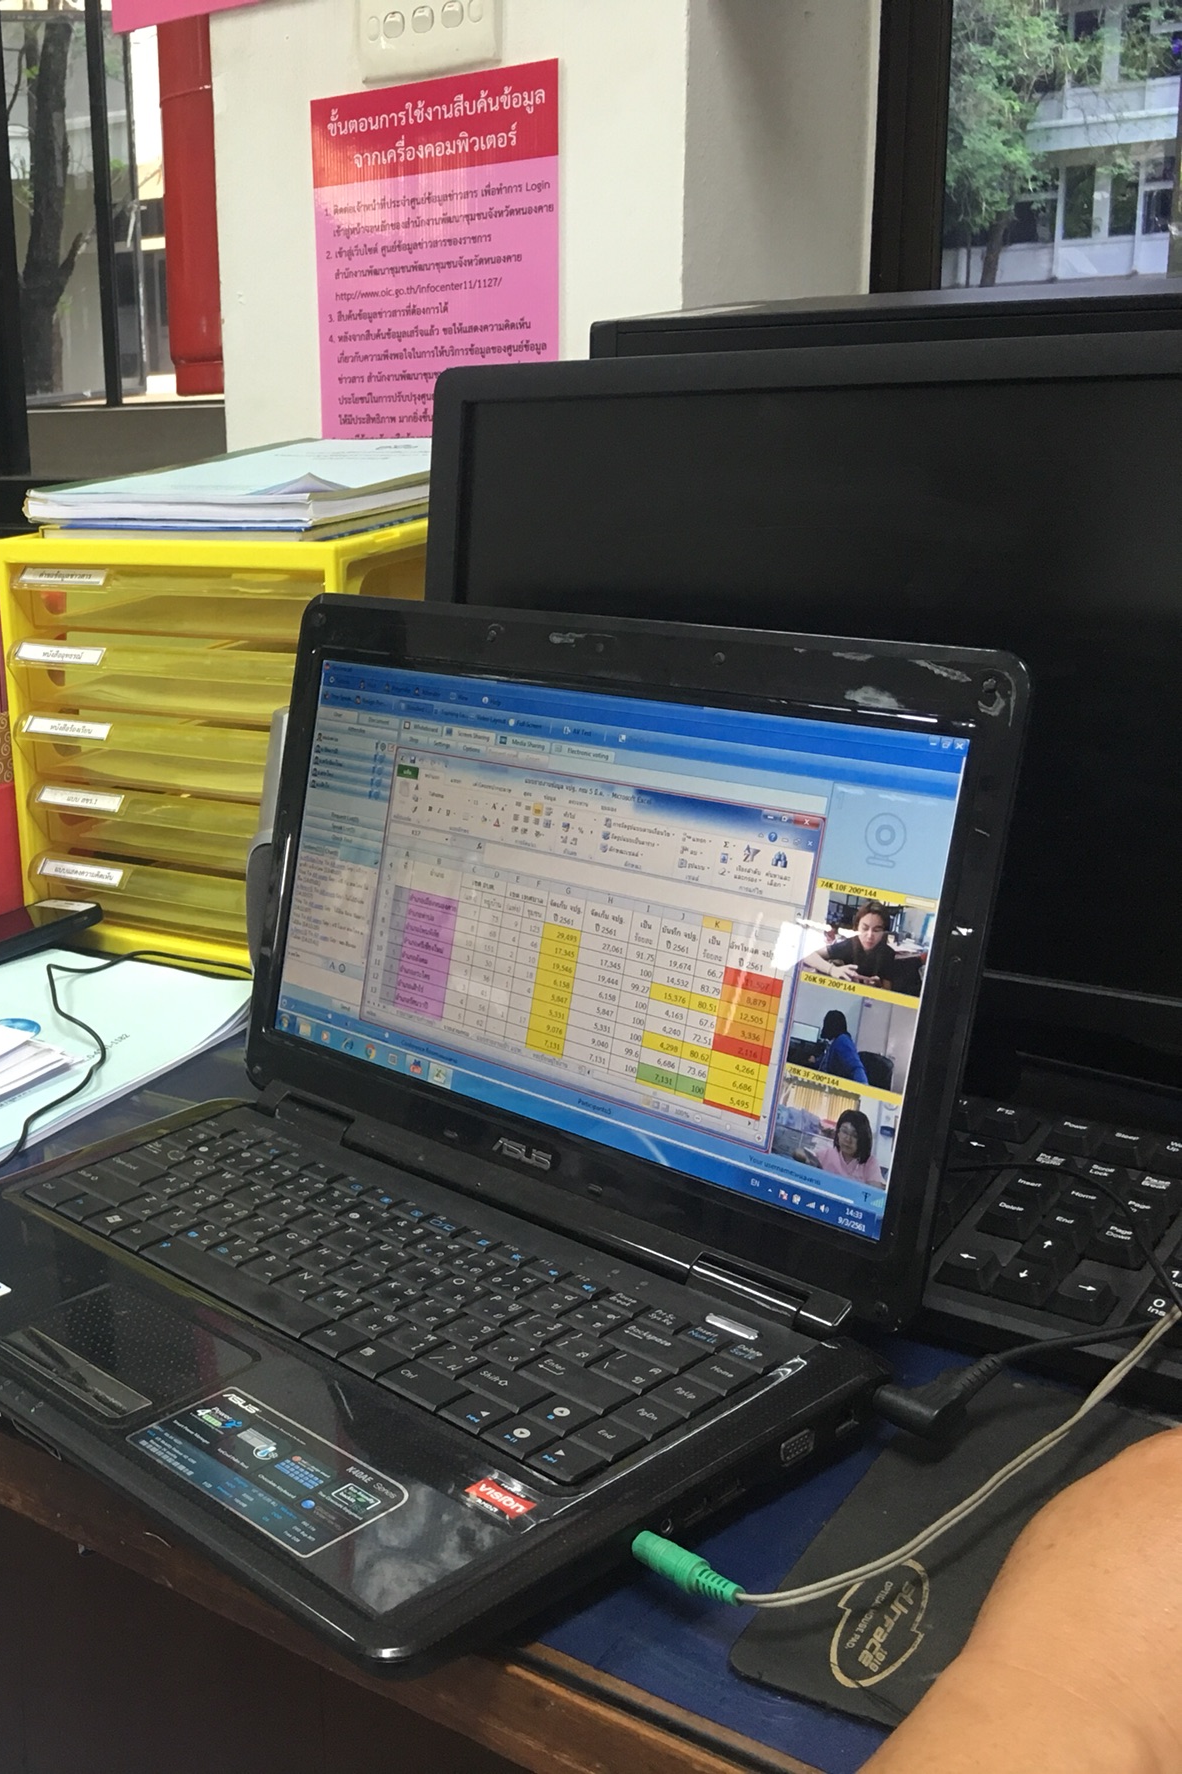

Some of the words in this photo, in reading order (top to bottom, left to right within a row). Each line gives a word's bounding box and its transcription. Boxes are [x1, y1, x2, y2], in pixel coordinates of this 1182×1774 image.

[328, 86, 545, 136] ขั้นตอนการใช้งานสืบค้นข้อมูล
[354, 122, 517, 168] จากเครื่องคอมพิวเตอร์
[481, 182, 522, 198] เพื่อทำการ
[526, 181, 550, 192] Login
[335, 277, 502, 301] http://www.oic.go.th/infocenter11/1127/
[328, 314, 334, 323] 3.
[329, 335, 335, 343] 4.
[338, 373, 364, 384] ข่าวสาร
[367, 369, 441, 383] สำนักงานพัฒนาชุมช
[512, 738, 526, 747] Media
[527, 741, 545, 751] Sharing
[612, 792, 635, 802] Microsoft
[820, 880, 833, 889] 74K
[560, 915, 574, 926] 2561
[601, 926, 617, 936] 2561
[673, 944, 689, 954] 2561
[602, 942, 623, 954] 27,061
[636, 950, 655, 962] 91.75
[669, 960, 692, 971] 19,674
[707, 967, 723, 979] 66.7
[746, 960, 763, 971] 2561
[555, 947, 575, 958] 17,345
[600, 959, 621, 971] 17,345
[641, 968, 652, 978] 100
[667, 976, 689, 988] 14,532
[700, 984, 720, 996] 83.79
[746, 996, 767, 1008] 8,879
[804, 975, 816, 984] 26K
[818, 978, 827, 986] 9F
[552, 962, 573, 974] 19,546
[598, 975, 619, 986] 19,444
[631, 982, 649, 994] 99.27
[664, 993, 686, 1005] 15,376
[698, 1001, 717, 1012] 80.51
[739, 1013, 764, 1025] 12,505
[553, 979, 570, 990] 6,158
[598, 992, 616, 1003] 6,158
[635, 1001, 647, 1010] 100
[665, 1010, 684, 1021] 4,163
[699, 1018, 715, 1029] 67.6
[741, 1032, 760, 1042] 3,336
[596, 1007, 614, 1018] 5,847
[632, 1016, 645, 1027] 100
[662, 1026, 681, 1037] 4,240
[693, 1034, 712, 1046] 72.51
[594, 1023, 611, 1034] 5,331
[630, 1033, 642, 1043] 100
[690, 1050, 709, 1062] 80.62
[735, 1065, 754, 1076] 4,266
[546, 1025, 563, 1036] 9,076
[591, 1039, 609, 1049] 9,040
[624, 1047, 639, 1058] 99.6
[657, 1058, 675, 1069] 6,686
[687, 1067, 706, 1079] 73.66
[732, 1081, 752, 1092] 6,686
[544, 1040, 560, 1051] 7,131
[589, 1054, 606, 1065] 7,131
[625, 1065, 637, 1075] 100
[654, 1073, 672, 1086] 7,131
[691, 1085, 704, 1095] 100
[729, 1096, 750, 1109] 5,495
[802, 1070, 811, 1078] 3F
[996, 1107, 1015, 1115] F12
[1064, 1121, 1088, 1130] Power
[1115, 1132, 1140, 1141] Sleep
[492, 1137, 552, 1170] ASUS
[1089, 1169, 1109, 1177] Lock
[1092, 1164, 1115, 1173] Scroll
[751, 1178, 759, 1188] EN
[1018, 1178, 1042, 1188] Insert
[1071, 1190, 1097, 1200] Home
[999, 1202, 1024, 1212] Delete
[1128, 1200, 1151, 1210] Page
[846, 1208, 863, 1219] 14:33
[837, 1216, 866, 1232] 9/3/2561
[1056, 1216, 1074, 1225] End
[1105, 1231, 1131, 1240] Down
[1110, 1226, 1133, 1236] Page
[1147, 1306, 1166, 1317] Ins
[324, 1328, 337, 1338] Alt
[627, 1325, 672, 1346] Backspace
[543, 1358, 566, 1372] Enter
[401, 1369, 418, 1379] Ctrl
[480, 1370, 499, 1383] Shift
[711, 1365, 734, 1378] Home
[673, 1386, 696, 1400] PgUp
[222, 1393, 261, 1415] ASUS
[637, 1408, 658, 1421] PgDn
[598, 1429, 615, 1440] End
[346, 1465, 373, 1484] K40AE
[373, 1481, 398, 1500] Series
[478, 1483, 525, 1513] vision
[858, 1581, 916, 1667] surface
[845, 1633, 860, 1650] PAD.
